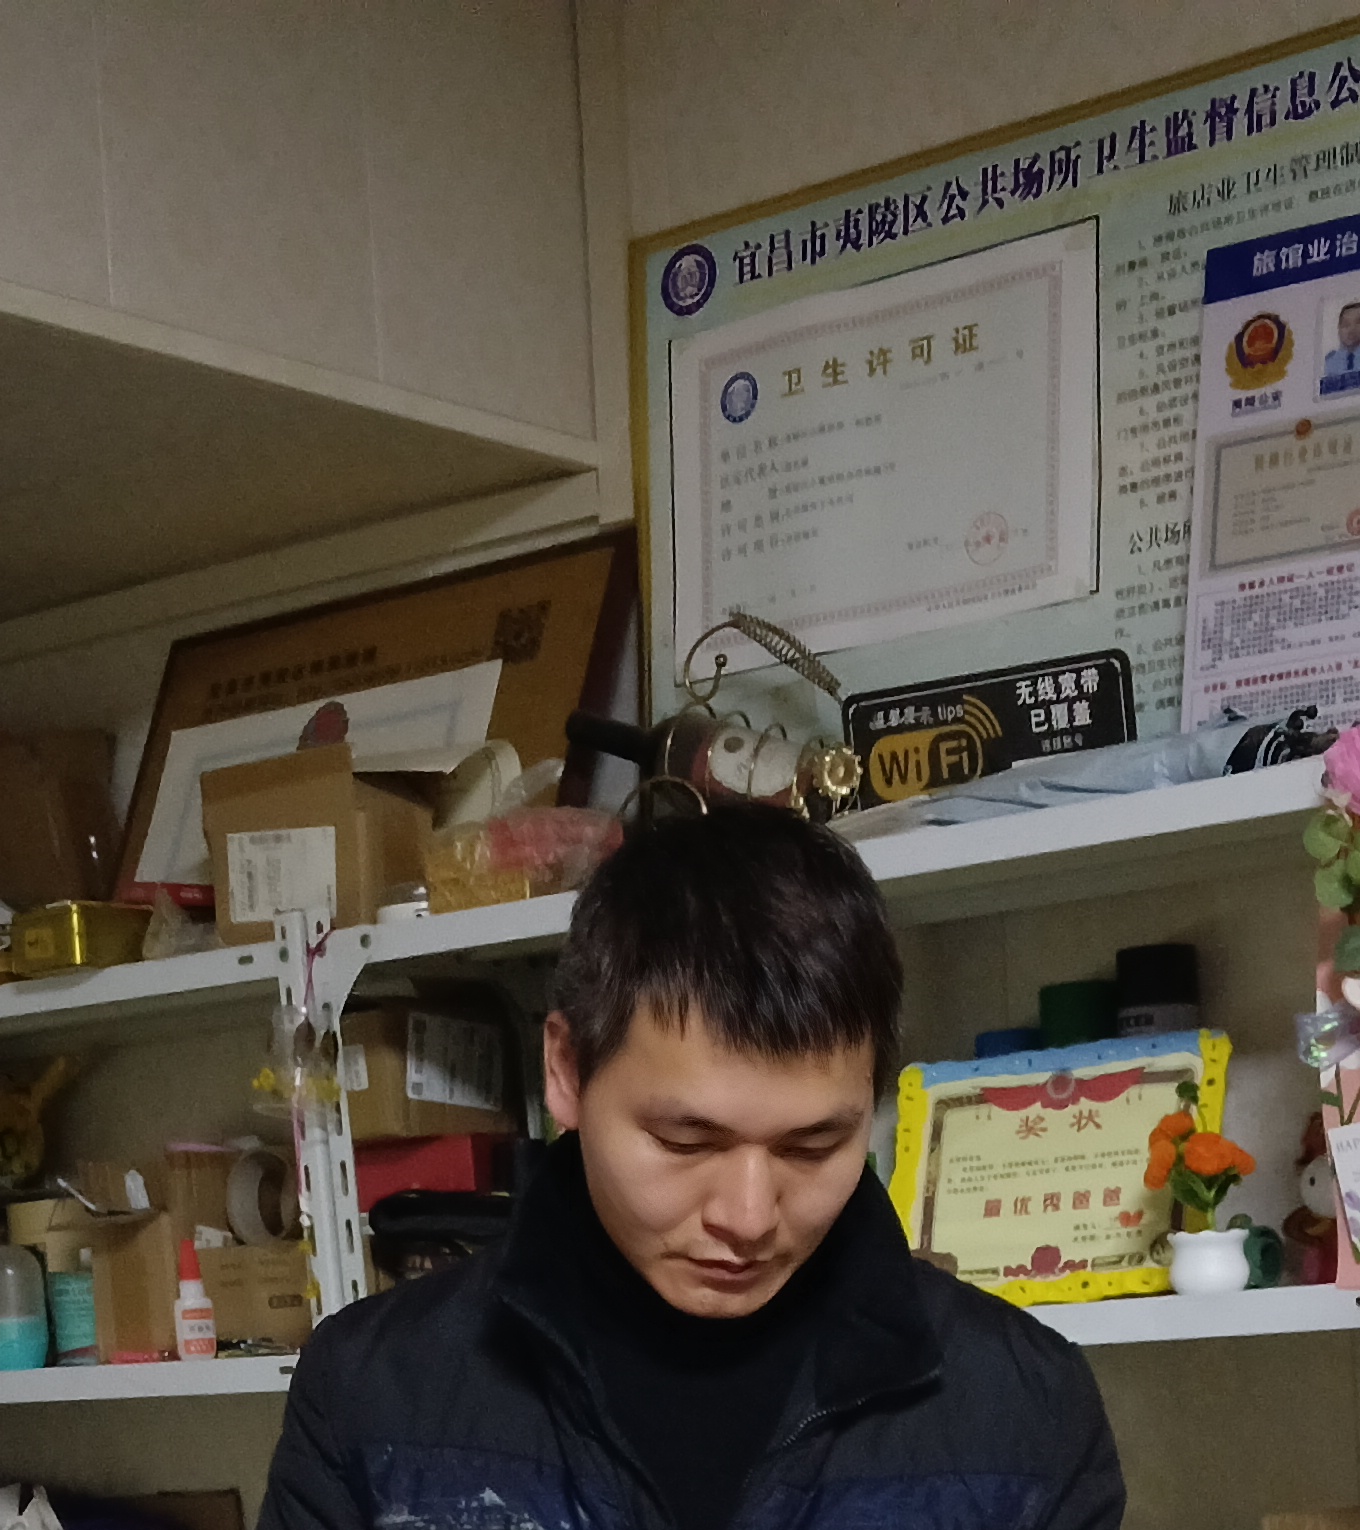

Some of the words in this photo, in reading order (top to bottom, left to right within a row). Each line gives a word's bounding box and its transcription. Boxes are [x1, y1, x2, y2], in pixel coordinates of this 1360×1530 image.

[780, 322, 980, 399] 卫生许可证
[1015, 666, 1100, 707] 无线宽带
[1030, 700, 1093, 734] 已覆盖
[1014, 1108, 1103, 1141] 奖状
